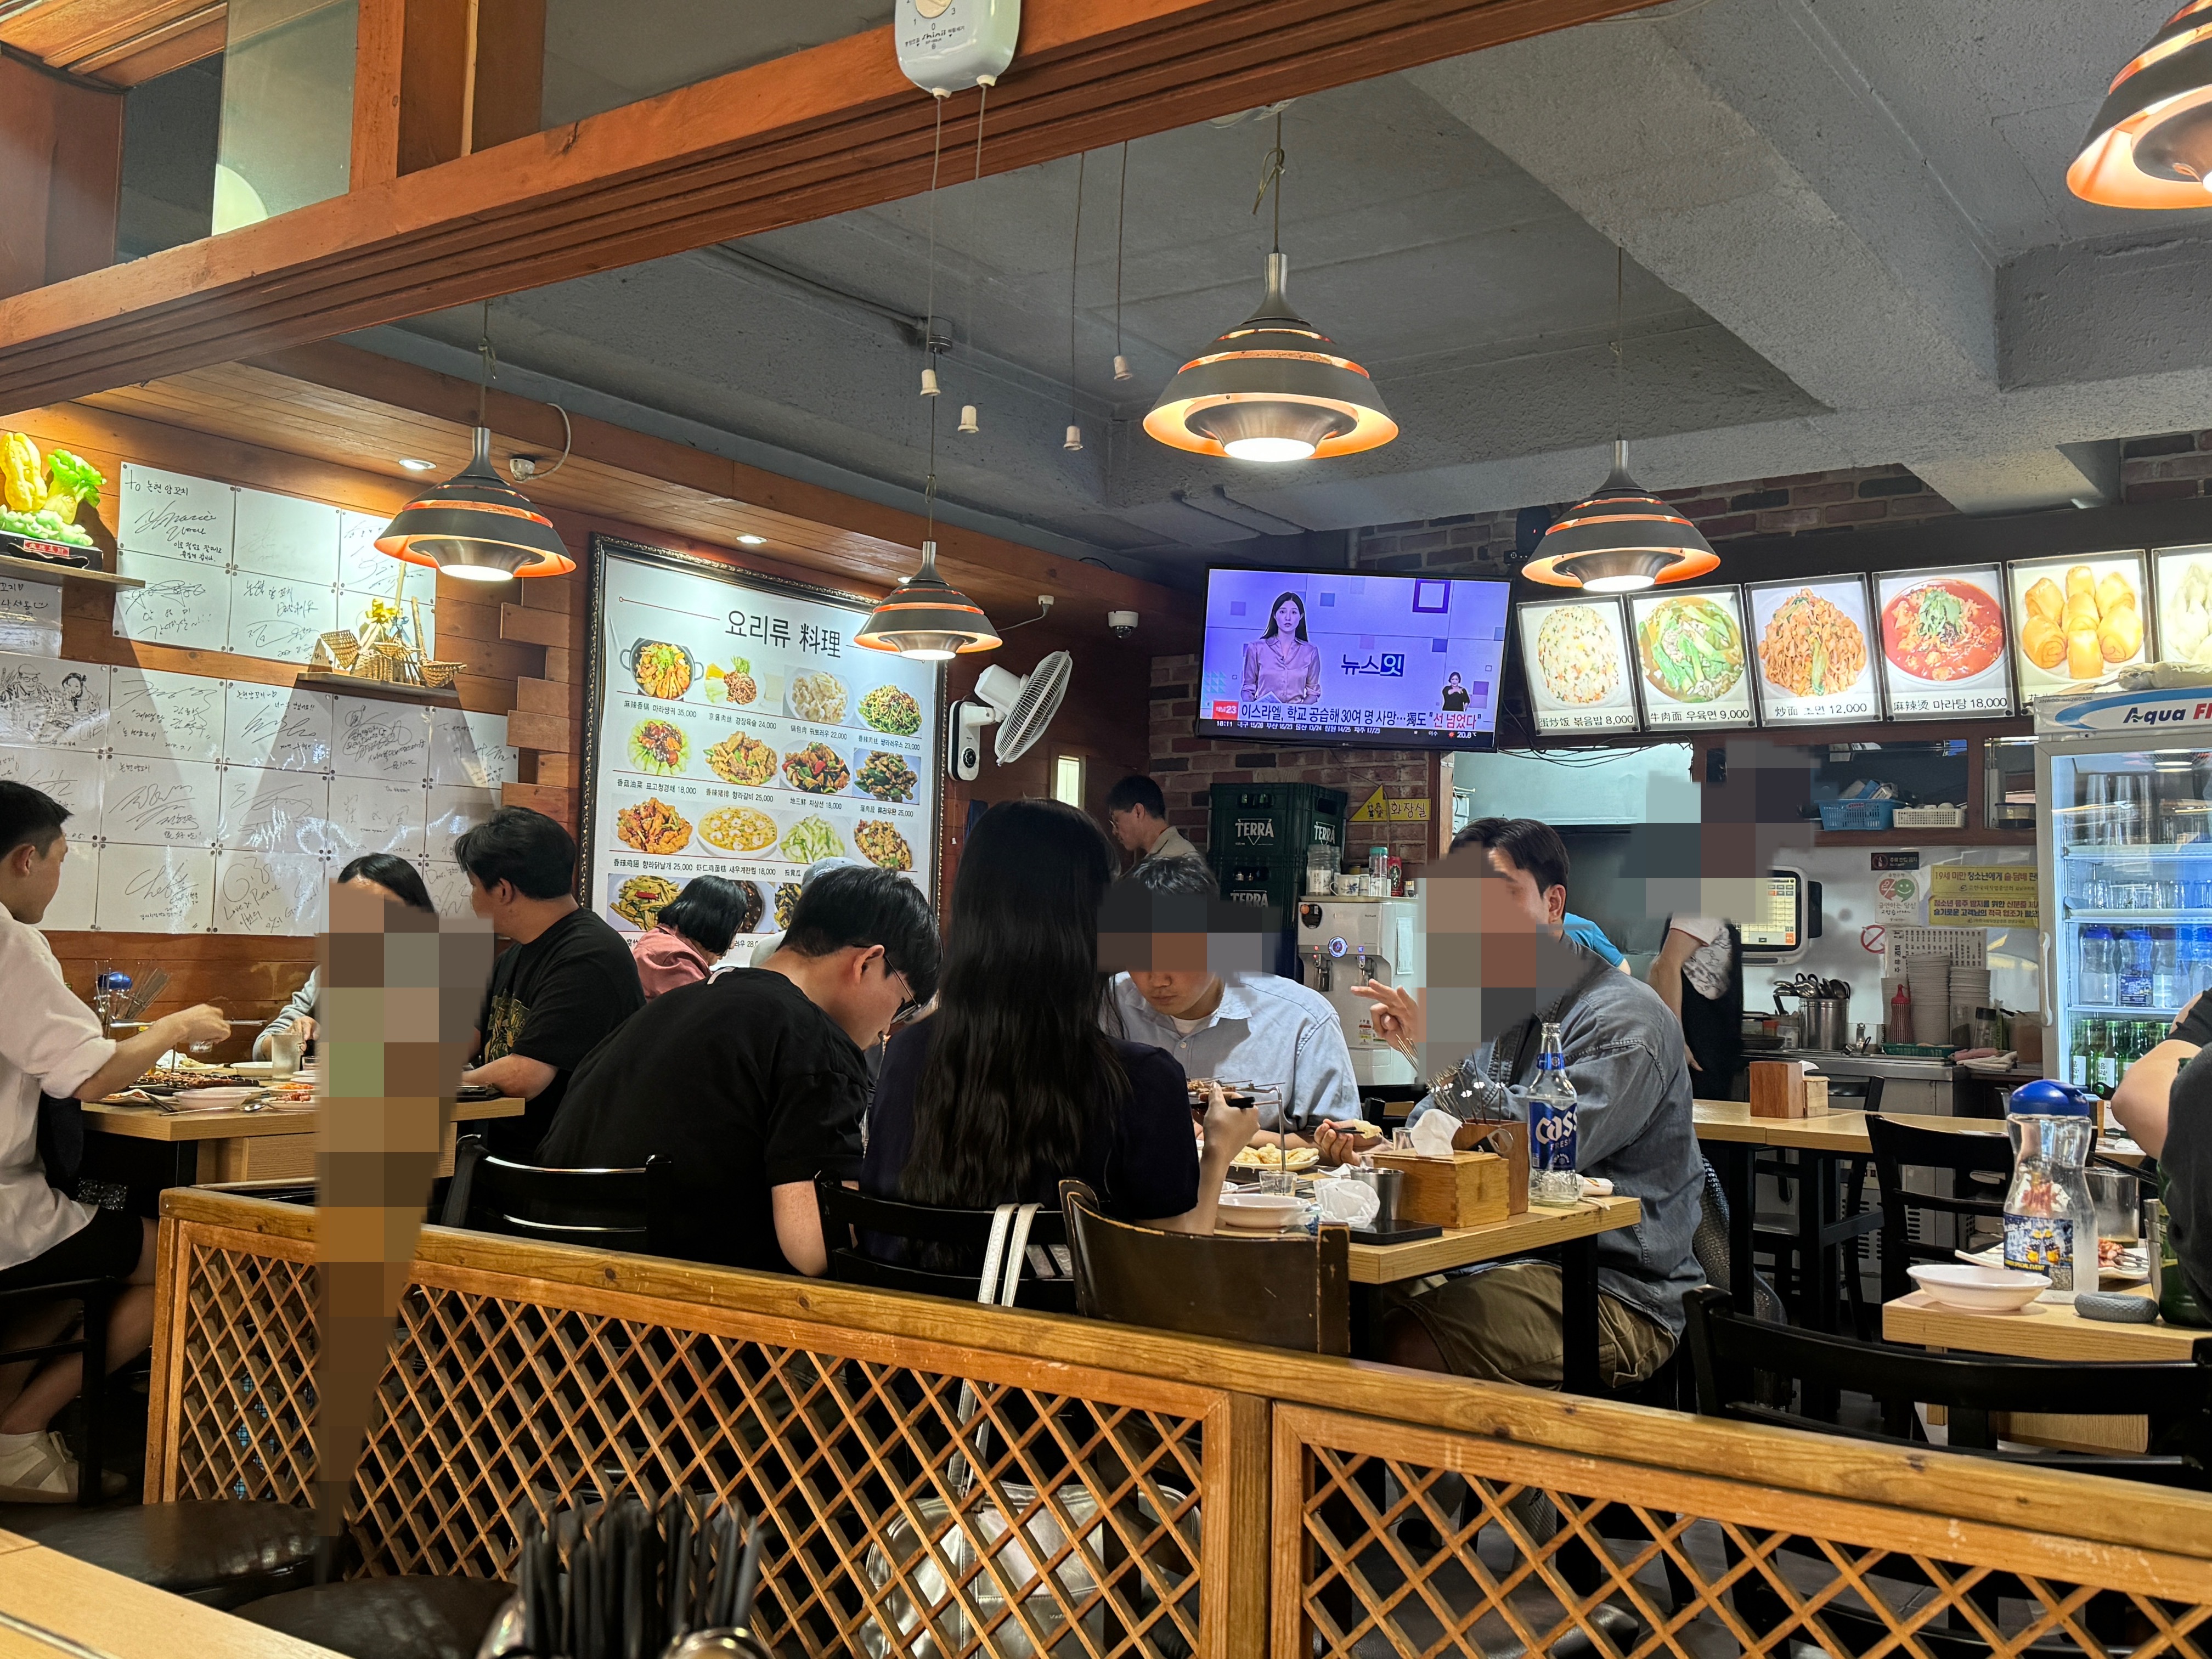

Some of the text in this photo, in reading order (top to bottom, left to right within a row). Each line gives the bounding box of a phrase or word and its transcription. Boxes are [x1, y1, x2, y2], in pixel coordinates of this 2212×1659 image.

[725, 611, 840, 658] 요리류 料理
[1341, 654, 1402, 675] 뉴스잇
[1775, 706, 1798, 716] 炒面
[1830, 703, 1867, 715] 12,000
[1933, 699, 1967, 710] 마라탕
[1971, 697, 2007, 709] 18,000
[677, 709, 697, 718] 35,000
[1242, 704, 1283, 721] 이스라엘,
[1288, 706, 1307, 721] 학교
[1309, 707, 1339, 724] 공습해
[1341, 709, 1362, 725] 30여
[1364, 710, 1374, 725] 명
[1650, 709, 1750, 722] 牛肉面 우육면 9,000
[2123, 707, 2186, 725] Aqua
[759, 720, 777, 729] 24,000
[1539, 715, 1634, 728] 蛋炒饭 볶음밥 8,000
[831, 731, 847, 740] 22,000
[905, 742, 920, 751] 23,000
[678, 786, 697, 794] 18,000
[755, 794, 774, 802] 25,000
[809, 800, 823, 808] 지삼선
[1391, 802, 1426, 818] 화장실
[1235, 822, 1274, 838] TERRA
[1314, 825, 1335, 844] TERRA
[1968, 872, 2002, 881] 청소년에게
[2029, 872, 2038, 881] 판
